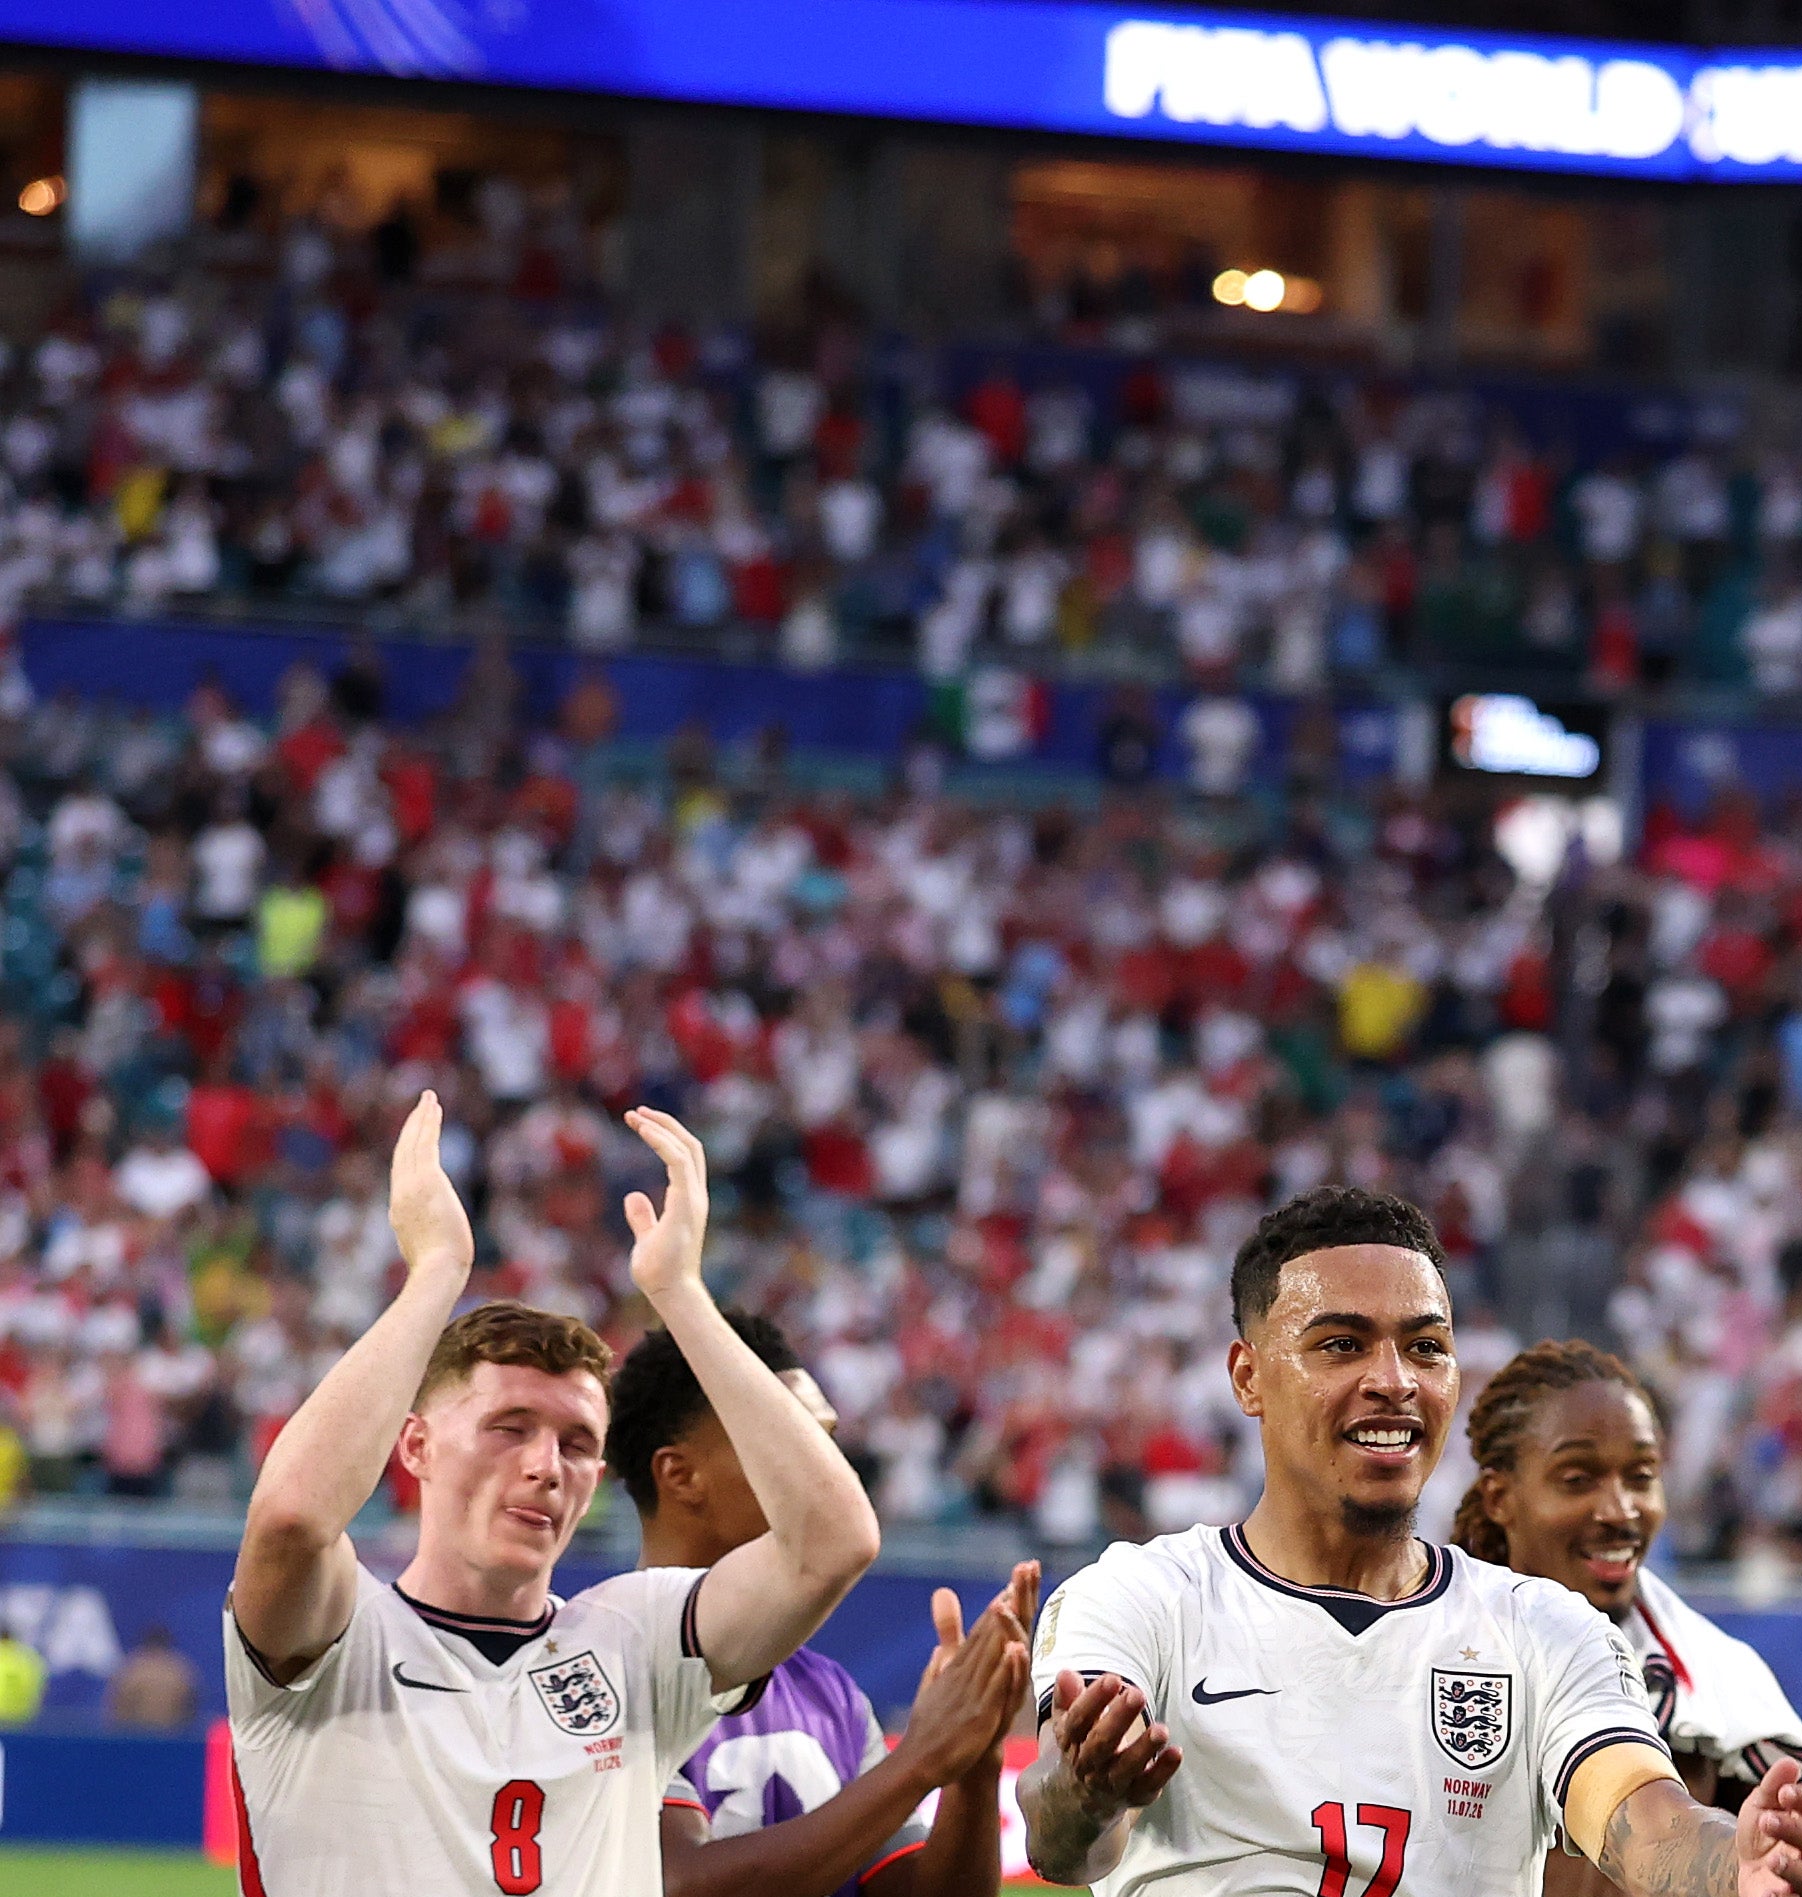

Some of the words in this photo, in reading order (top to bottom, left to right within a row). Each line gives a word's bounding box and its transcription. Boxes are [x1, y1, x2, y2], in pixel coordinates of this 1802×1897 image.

[1443, 1777, 1493, 1799] NORWAY
[1447, 1798, 1484, 1819] 11.07.26
[490, 1778, 546, 1897] 8
